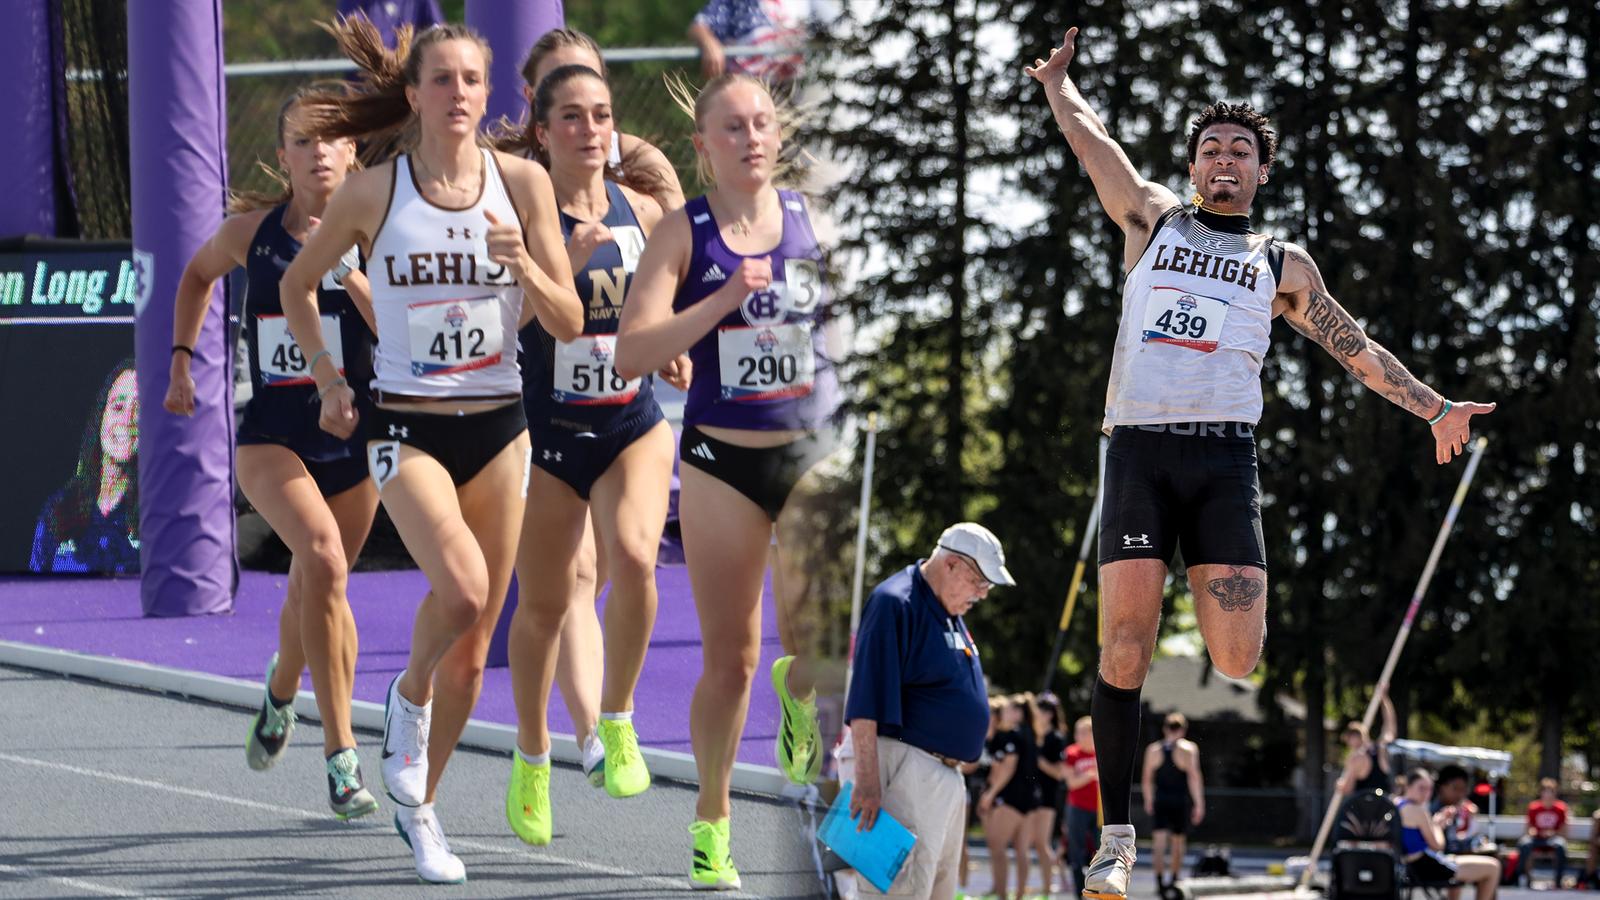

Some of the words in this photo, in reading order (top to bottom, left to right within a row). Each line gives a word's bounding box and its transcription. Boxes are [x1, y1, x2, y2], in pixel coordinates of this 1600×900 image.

[384, 252, 518, 287] LEHI
[1151, 244, 1260, 292] LEHIGH
[31, 260, 110, 314] Long
[588, 266, 628, 308] N
[794, 263, 816, 309] 3
[589, 307, 622, 320] NAVY
[1155, 309, 1207, 339] 439
[429, 328, 486, 361] 412
[572, 363, 627, 393] 518
[738, 354, 797, 387] 290
[376, 445, 394, 483] 5
